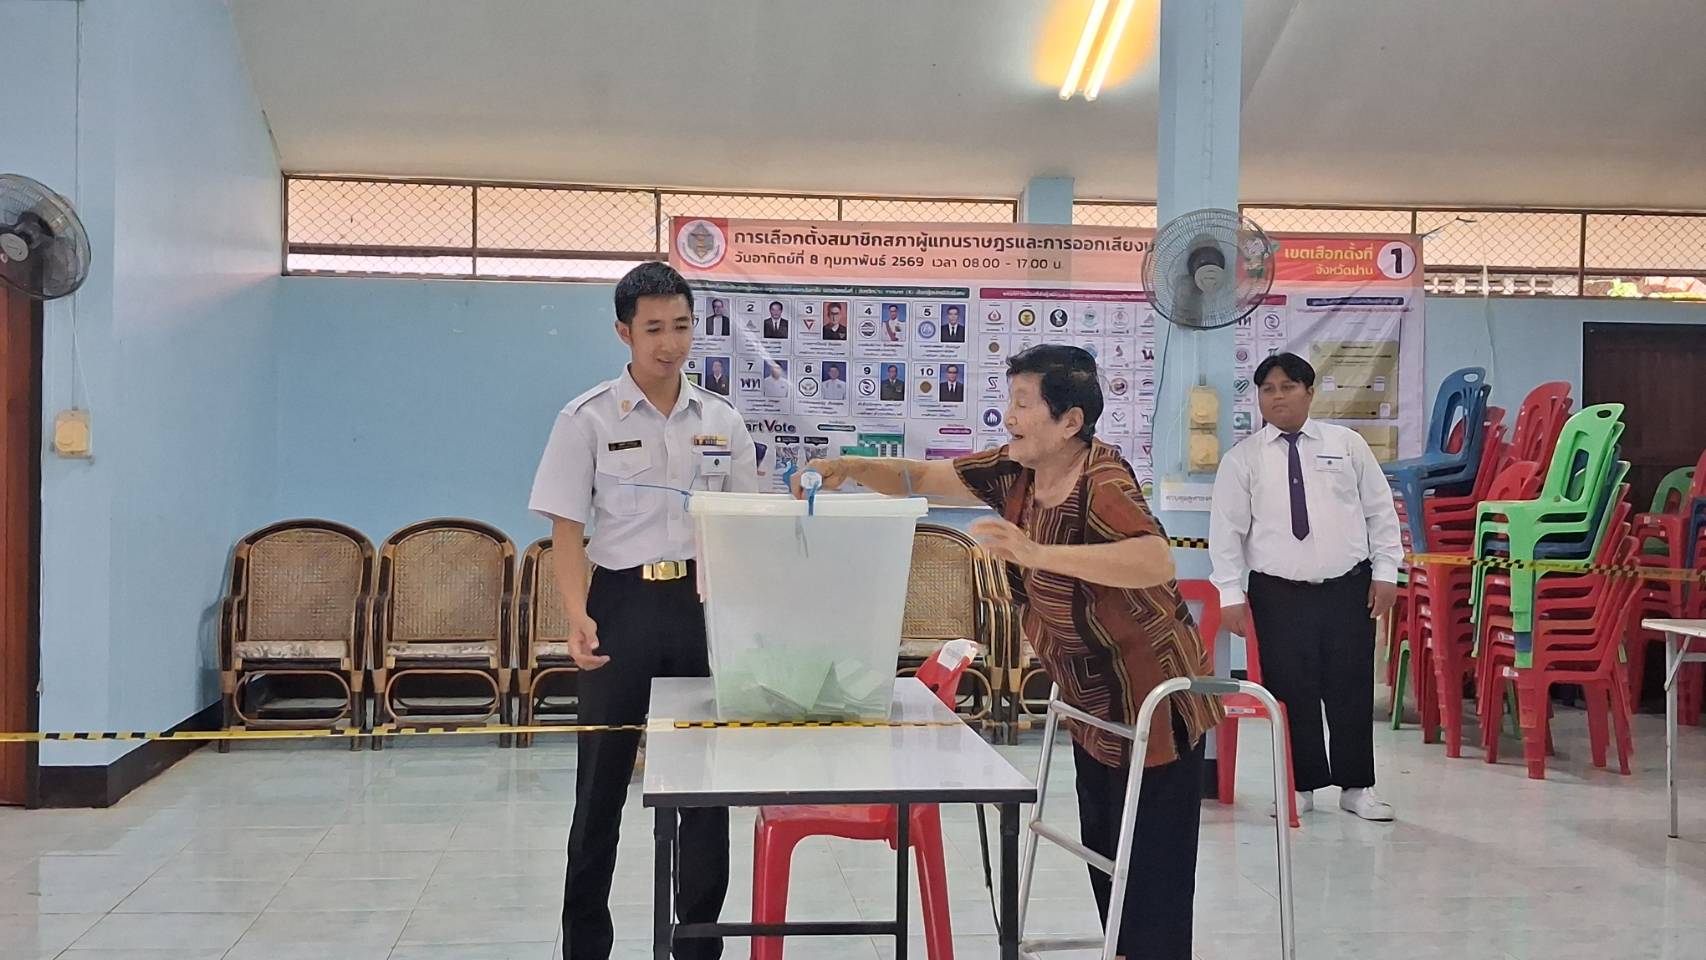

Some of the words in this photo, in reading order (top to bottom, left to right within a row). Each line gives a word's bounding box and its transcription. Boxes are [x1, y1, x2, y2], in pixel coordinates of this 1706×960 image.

[1284, 242, 1374, 260] เขตเลือกตั้งที่
[735, 250, 804, 266] วันอาทิตย์ที่
[810, 254, 818, 265] 8
[824, 254, 887, 268] กุมภาพันธ์
[892, 256, 924, 267] 2569
[932, 258, 957, 268] เวลา
[961, 257, 1000, 268] 0800
[1016, 258, 1048, 269] 1700
[1053, 260, 1062, 270] น
[1391, 247, 1402, 274] 1
[746, 304, 754, 312] 2
[805, 306, 813, 314] 3
[864, 307, 872, 315] 4
[924, 308, 932, 316] 5
[688, 361, 696, 369] 6
[746, 362, 754, 371] 7
[804, 365, 812, 373] 8
[863, 367, 871, 375] 9
[920, 368, 934, 376] 10
[745, 422, 762, 432] art
[764, 419, 796, 432] Vote
